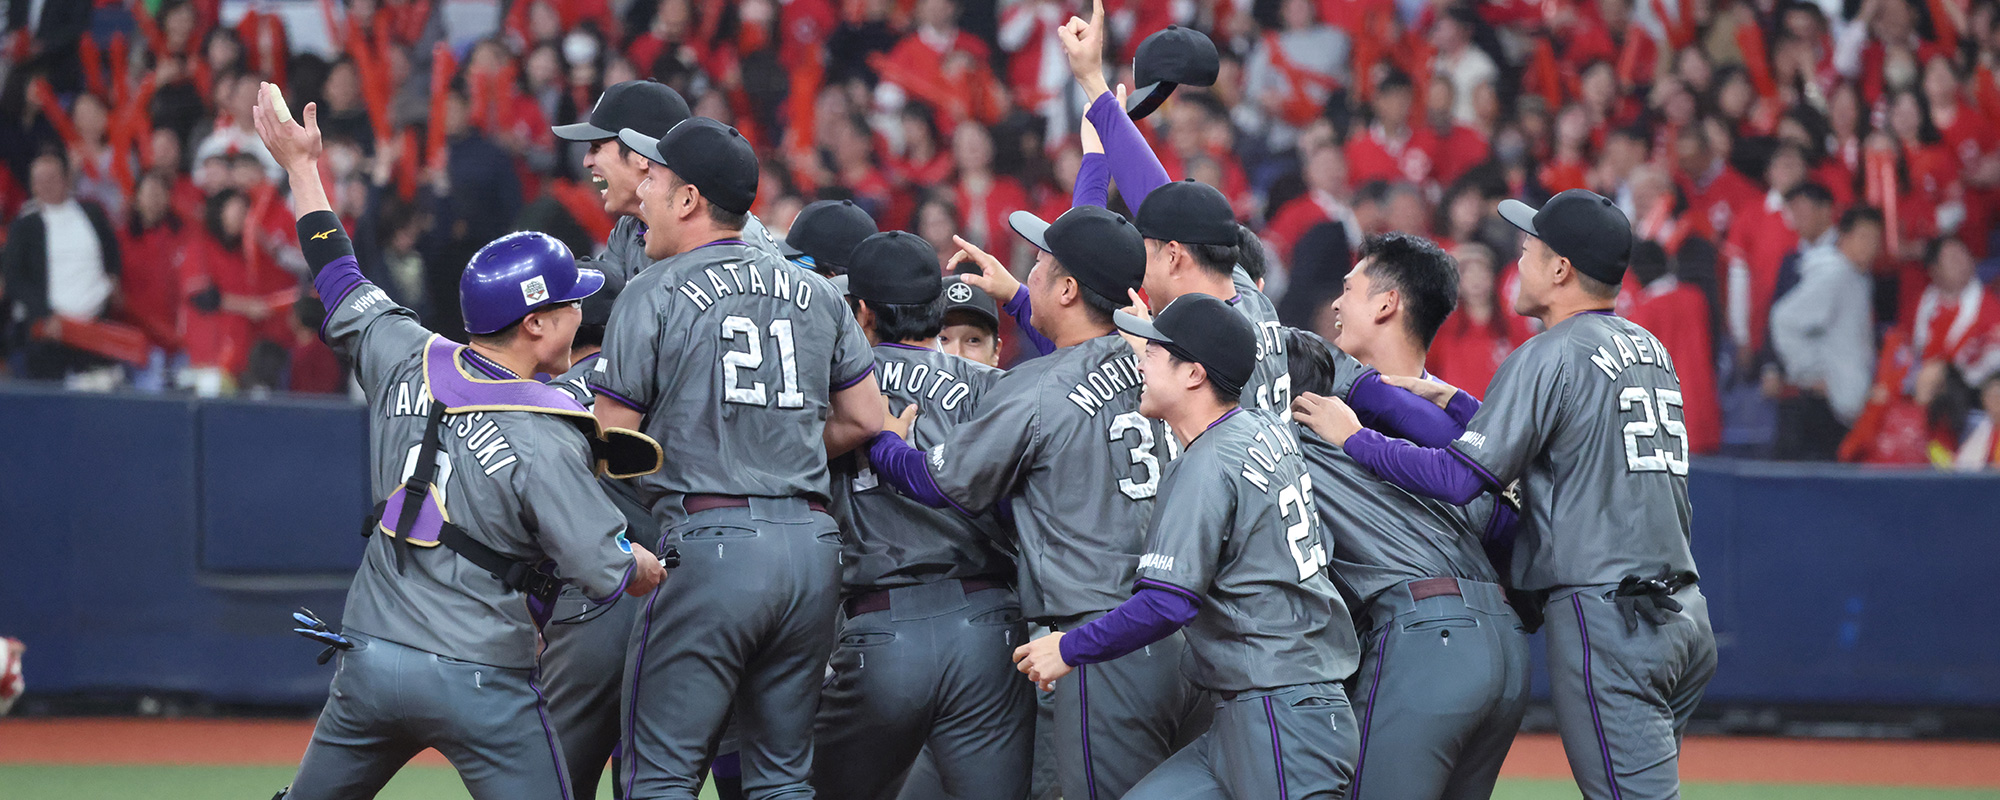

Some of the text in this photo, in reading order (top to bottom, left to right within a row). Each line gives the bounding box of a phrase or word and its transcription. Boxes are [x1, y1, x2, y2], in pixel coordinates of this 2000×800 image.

[678, 263, 813, 312] HATANO
[721, 314, 805, 408] 21
[1590, 334, 1681, 383] MAEN
[1618, 386, 1690, 476] 25
